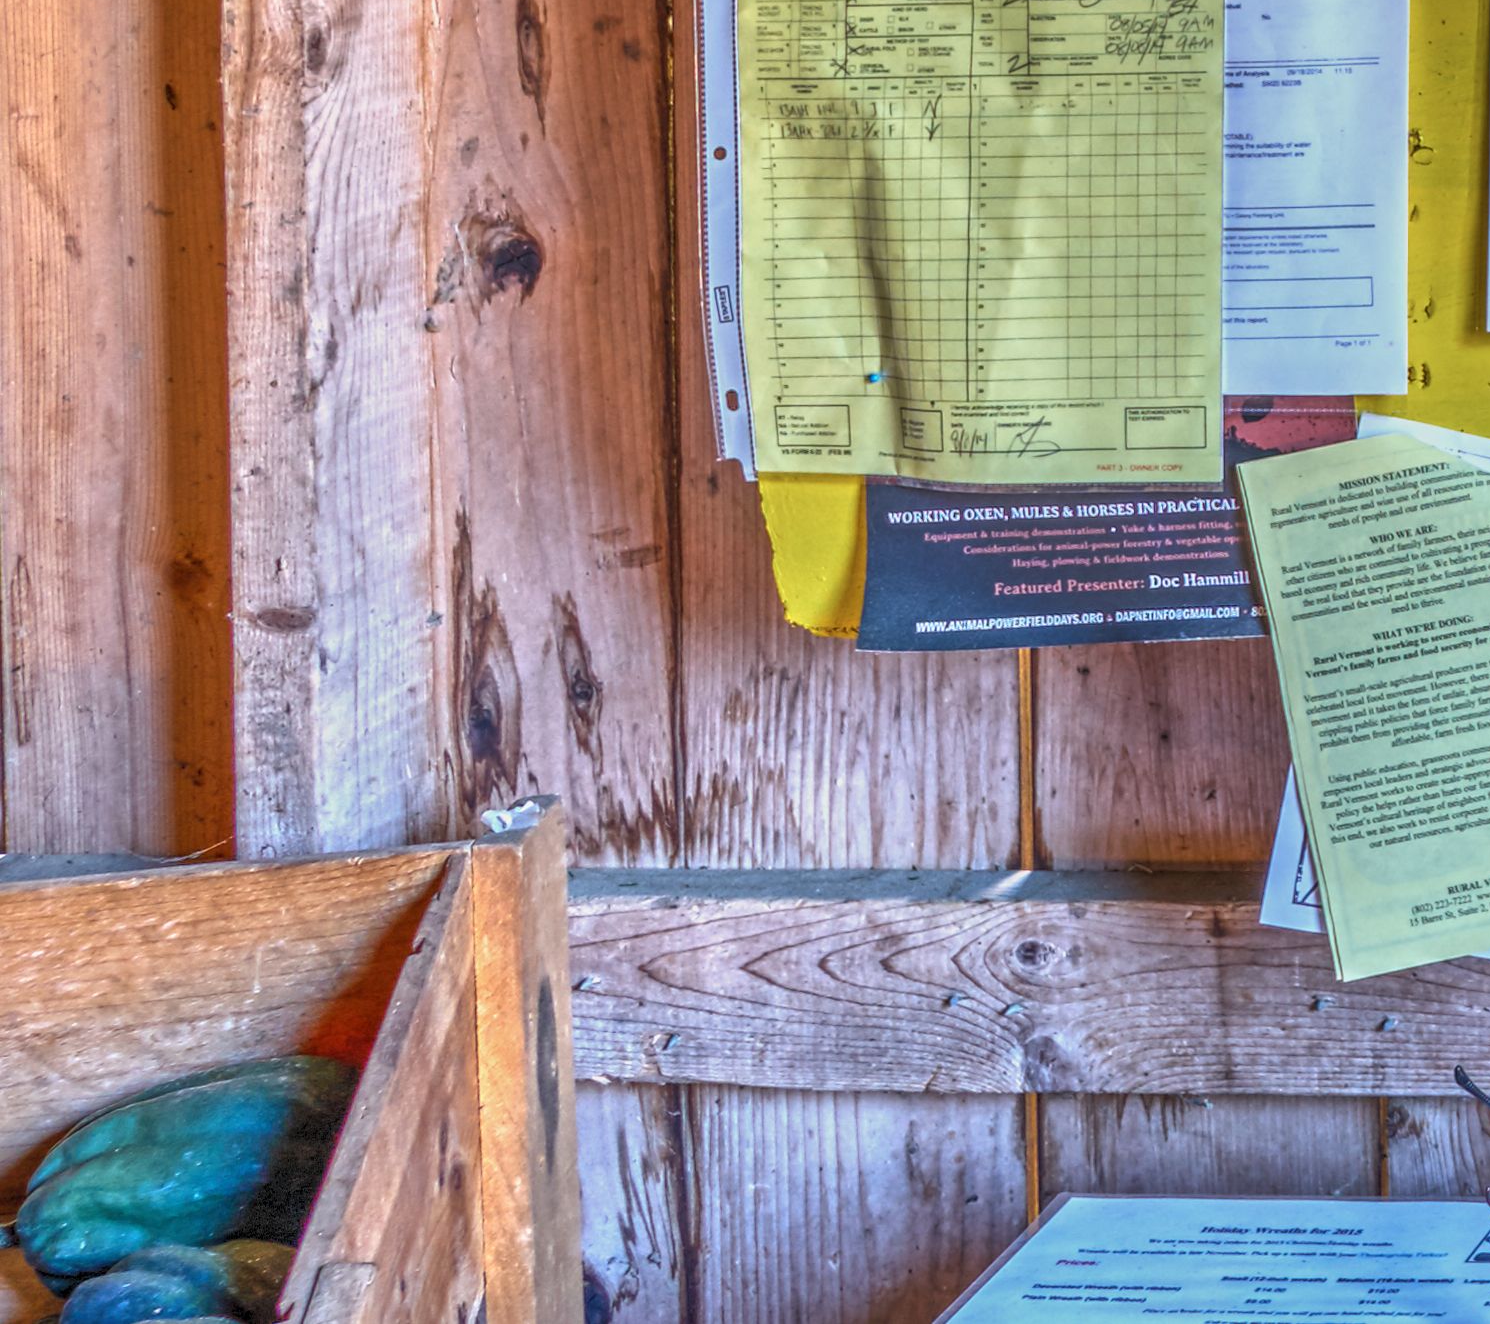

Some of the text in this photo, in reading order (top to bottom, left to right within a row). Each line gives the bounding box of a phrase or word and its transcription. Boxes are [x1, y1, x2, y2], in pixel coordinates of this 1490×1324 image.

[994, 571, 1250, 595] Featured Presenter: Doc Hammill
